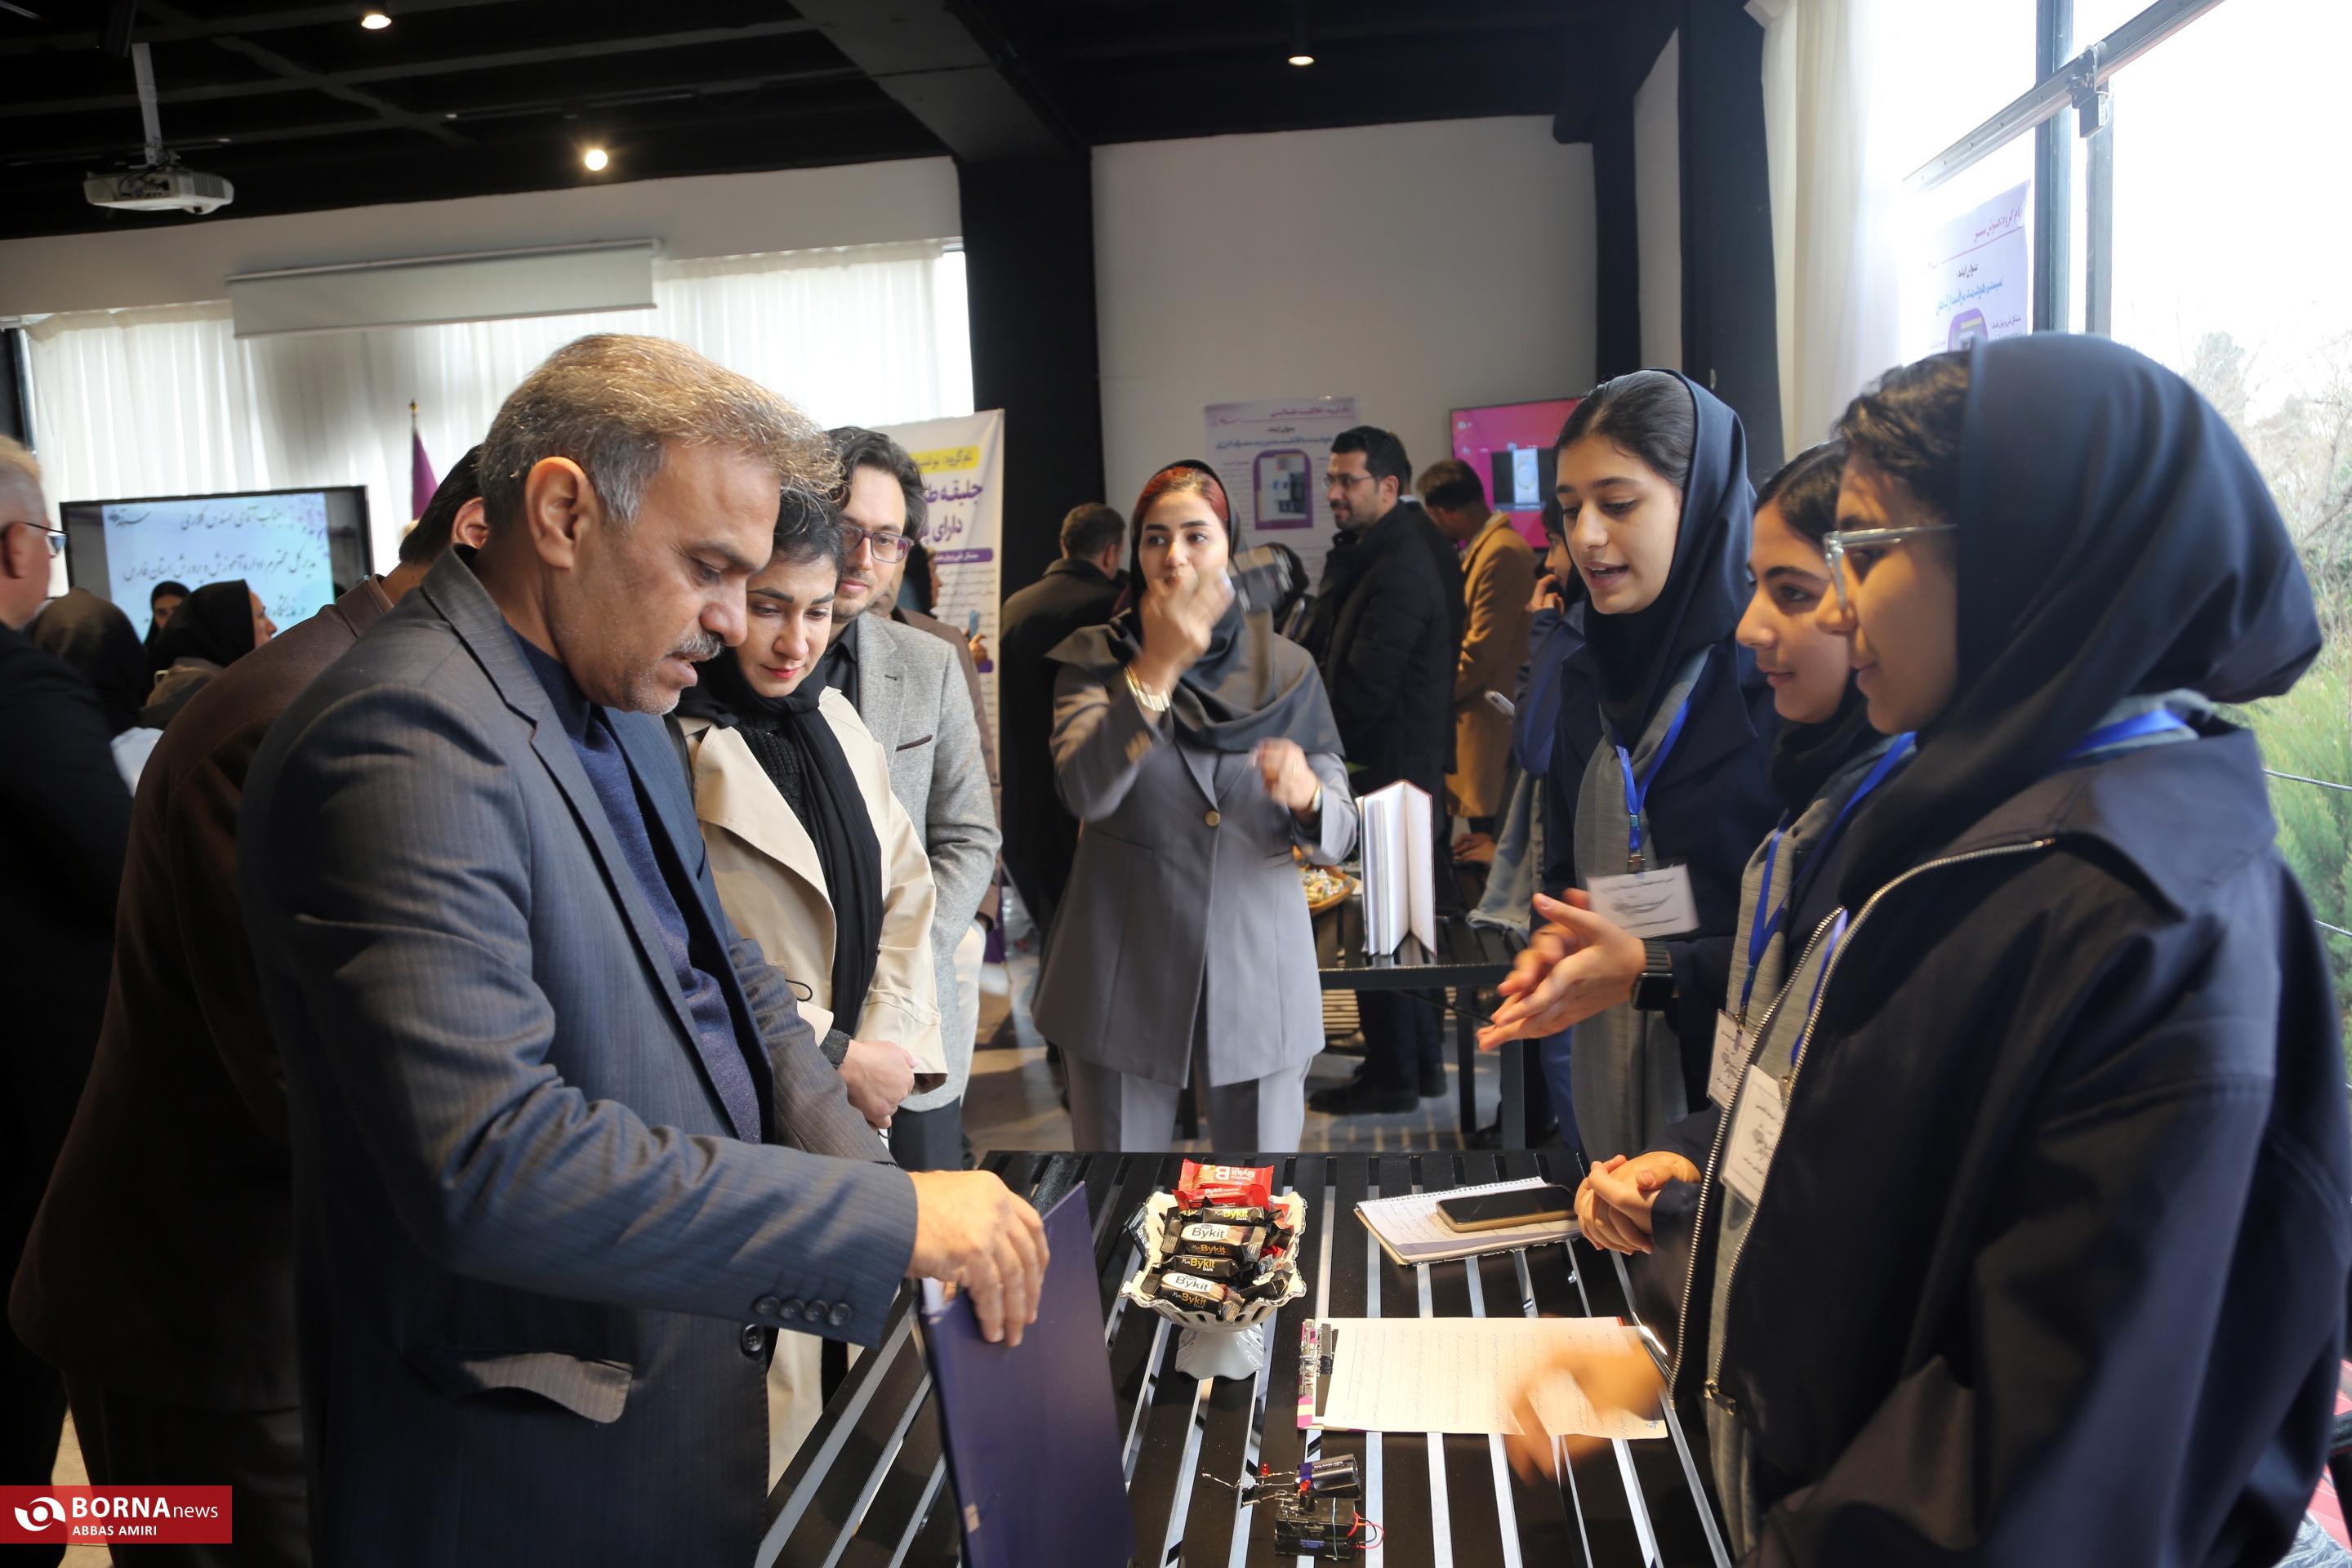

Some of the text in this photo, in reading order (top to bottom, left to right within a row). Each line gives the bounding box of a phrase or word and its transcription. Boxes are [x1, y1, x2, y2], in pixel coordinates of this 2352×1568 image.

[941, 479, 982, 506] جلیقه
[933, 514, 963, 542] دارای
[209, 550, 247, 577] آموزش
[1205, 1187, 1223, 1195] Bykit
[1223, 1209, 1249, 1219] Bykit
[1192, 1227, 1224, 1238] Bykit
[1200, 1244, 1227, 1254] Bykit
[1190, 1258, 1216, 1269] Bykit
[1175, 1276, 1209, 1291] Bykit
[1181, 1292, 1207, 1307] Bykit
